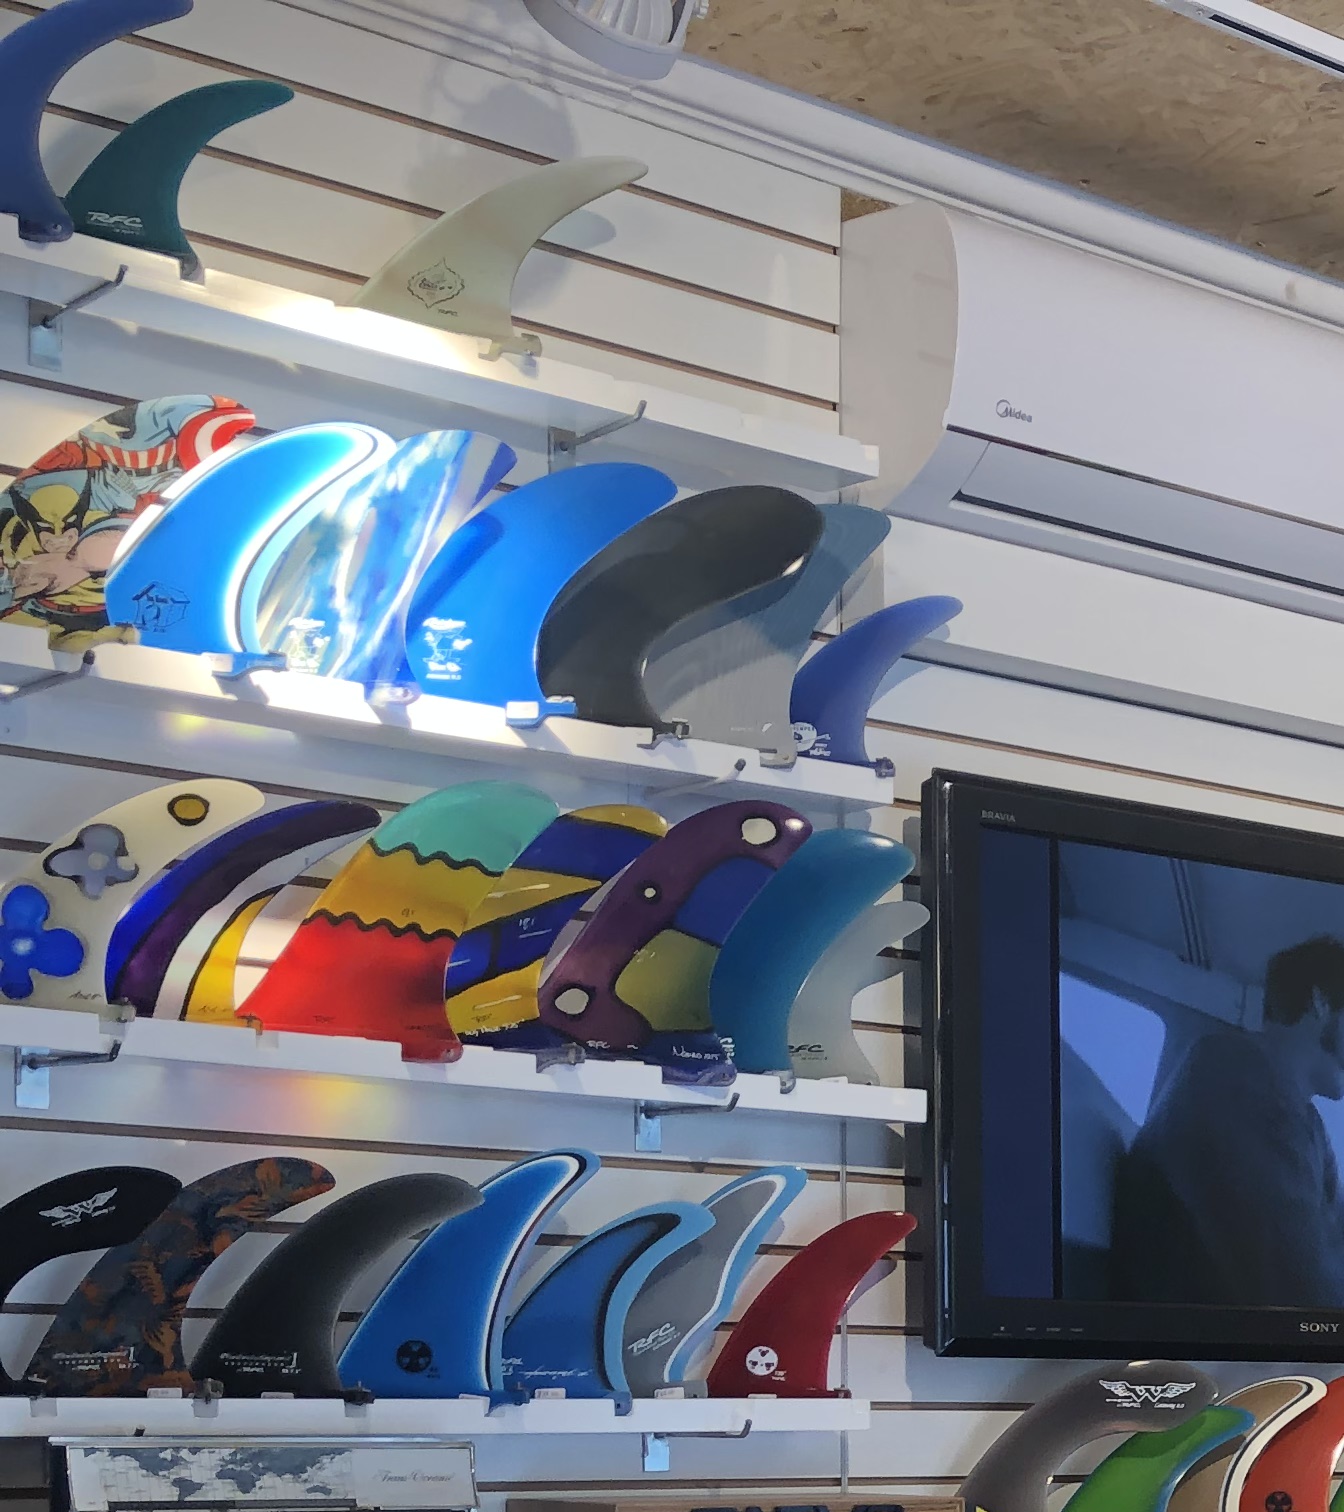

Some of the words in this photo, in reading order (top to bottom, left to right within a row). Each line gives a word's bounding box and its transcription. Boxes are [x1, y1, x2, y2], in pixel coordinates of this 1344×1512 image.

[995, 399, 1033, 424] Midea
[980, 809, 1016, 823] BRAVIA
[1299, 1321, 1340, 1333] SONY
